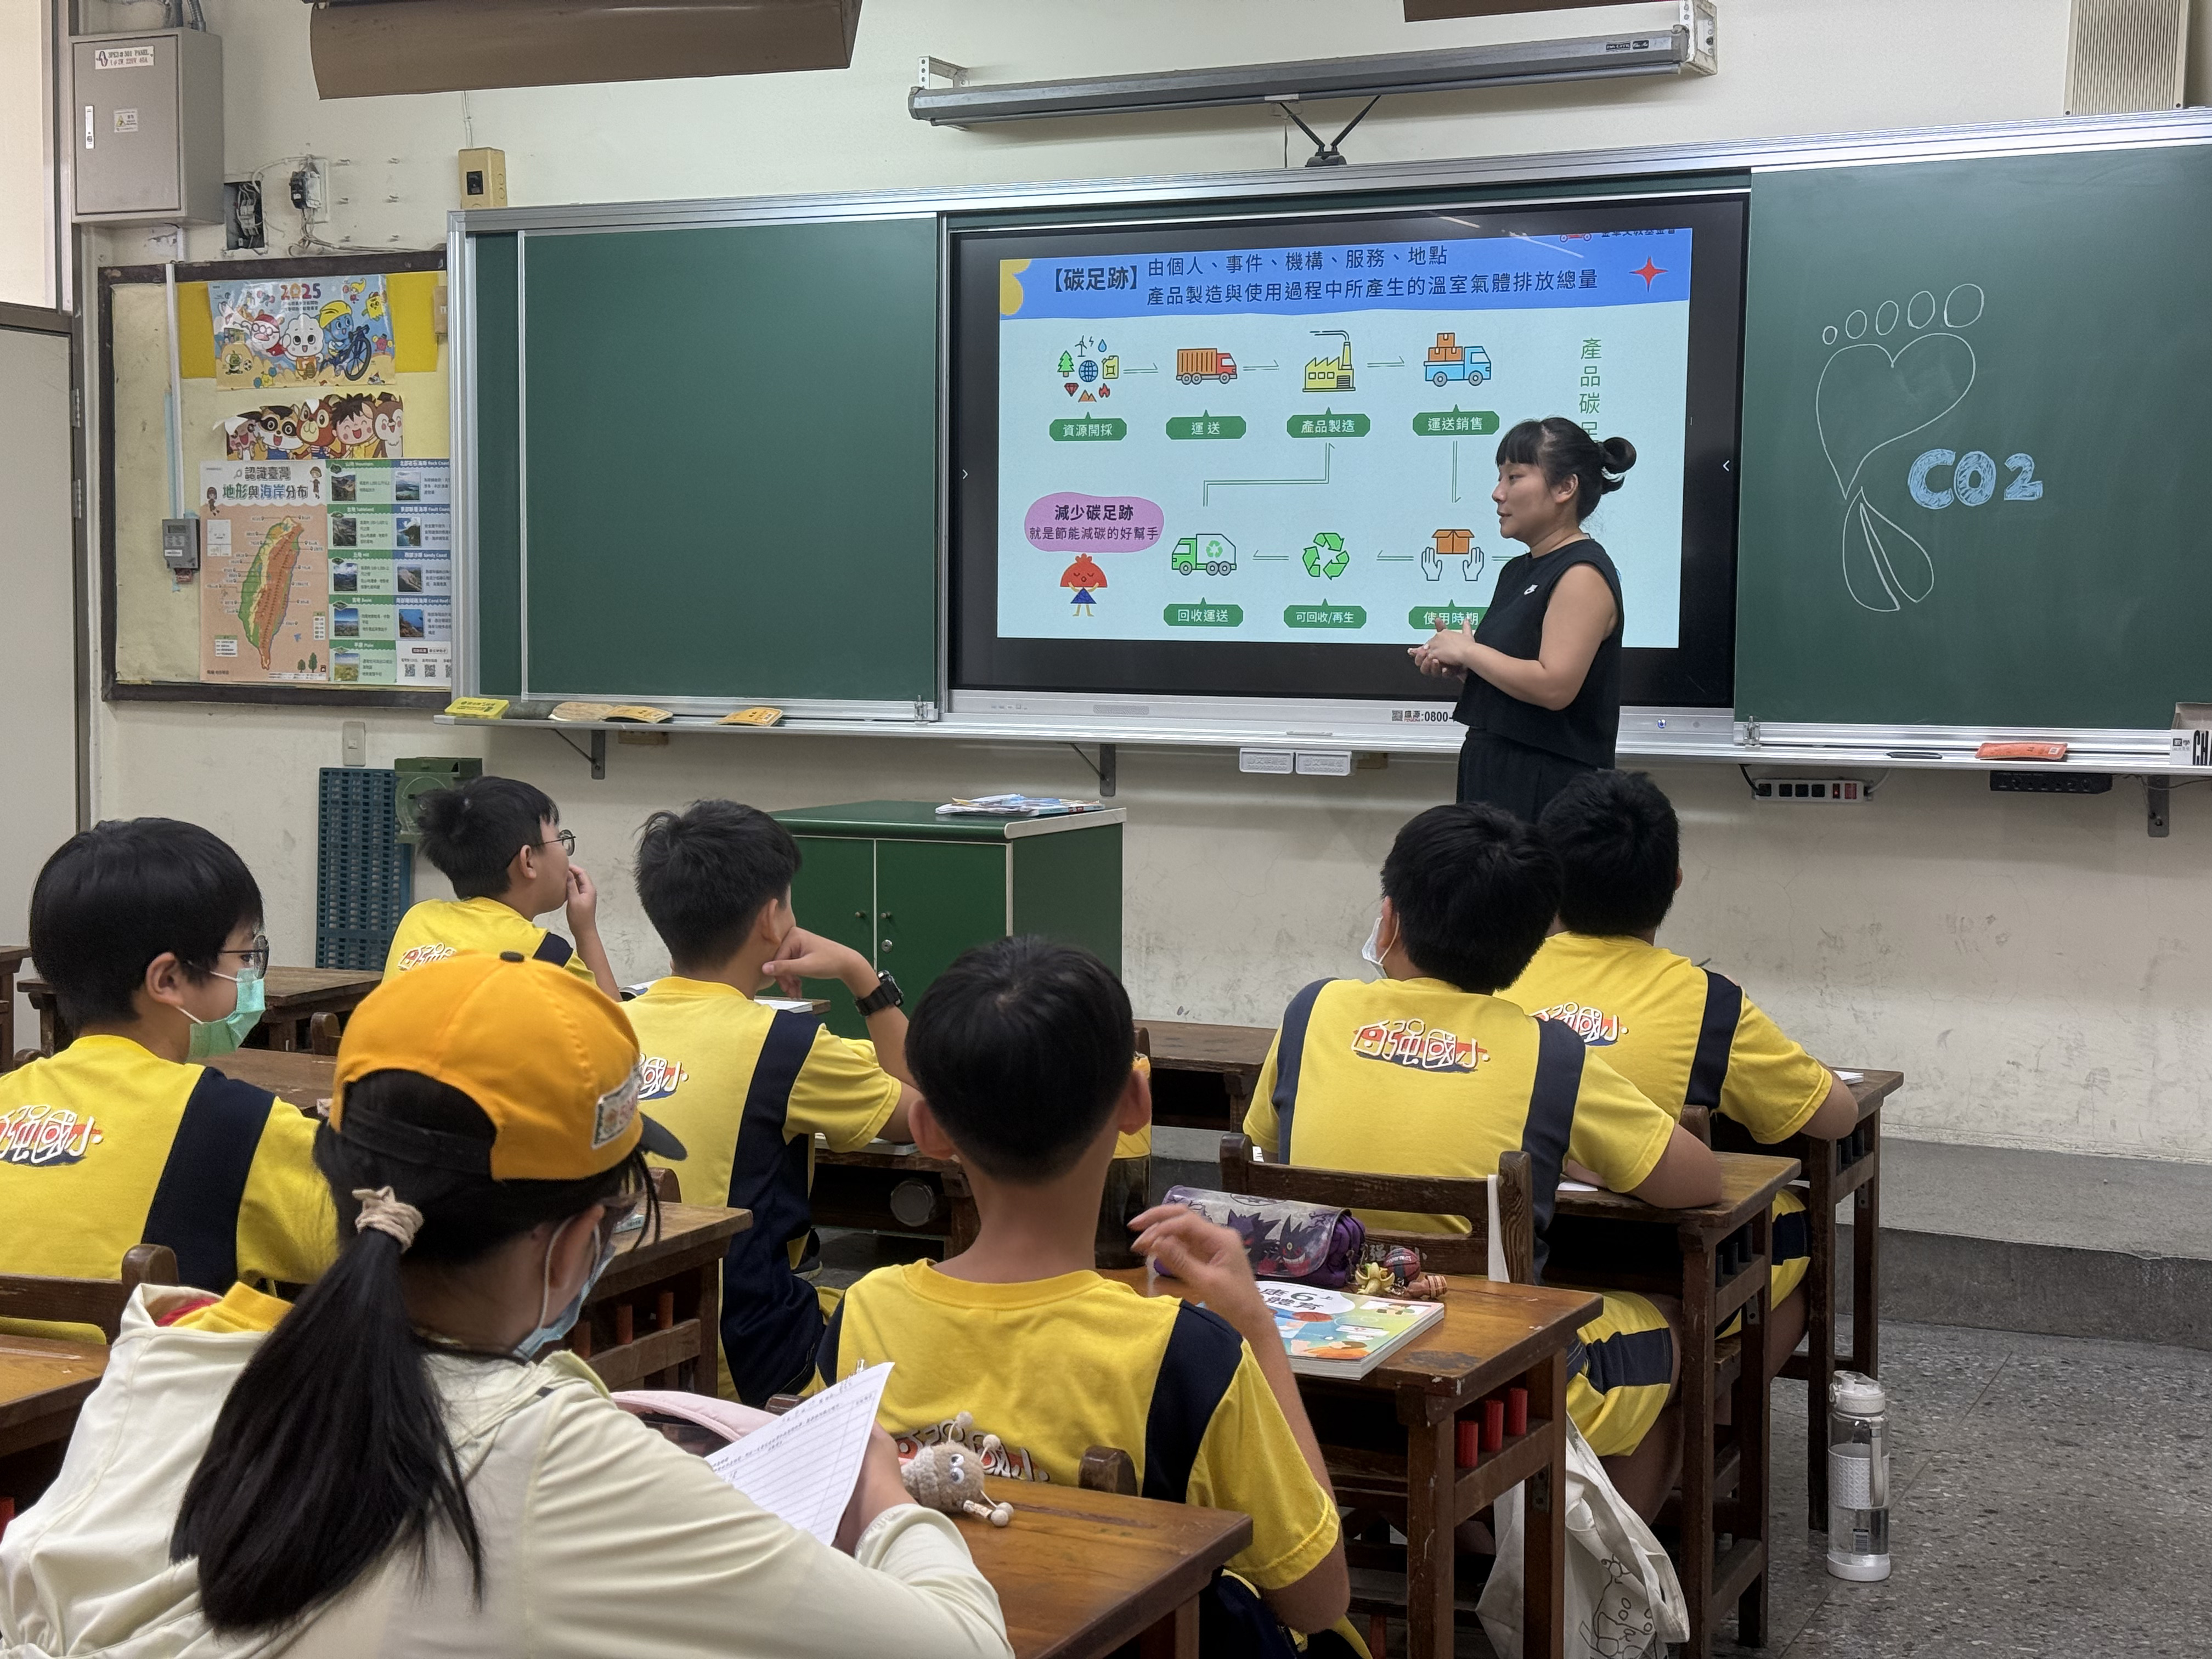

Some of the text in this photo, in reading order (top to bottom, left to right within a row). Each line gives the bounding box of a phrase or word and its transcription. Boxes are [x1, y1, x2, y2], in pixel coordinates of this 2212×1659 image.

[1148, 245, 1448, 278] 由個人、事件、機構、服務、地點
[1054, 265, 1137, 292] 【碳足跡】
[280, 283, 322, 301] 2025
[1147, 268, 1598, 307] 產品製造與使用過程中所產生的溫室氣體排放總量
[1062, 424, 1113, 438] 資源開採
[1190, 421, 1221, 436] 運送
[1300, 419, 1356, 435] 產品製造
[1427, 416, 1483, 432] 運送銷售
[244, 466, 291, 481] 認識臺灣
[1908, 448, 2044, 510] CO2
[223, 483, 308, 500] 地形與海岸分布
[1054, 504, 1135, 522] 減少碳足跡
[1029, 526, 1159, 541] 就是節能減碳的好幫手
[1177, 608, 1229, 623] 回收運送
[1295, 611, 1355, 624] 可回收/再生
[1290, 1293, 1318, 1301] 6
